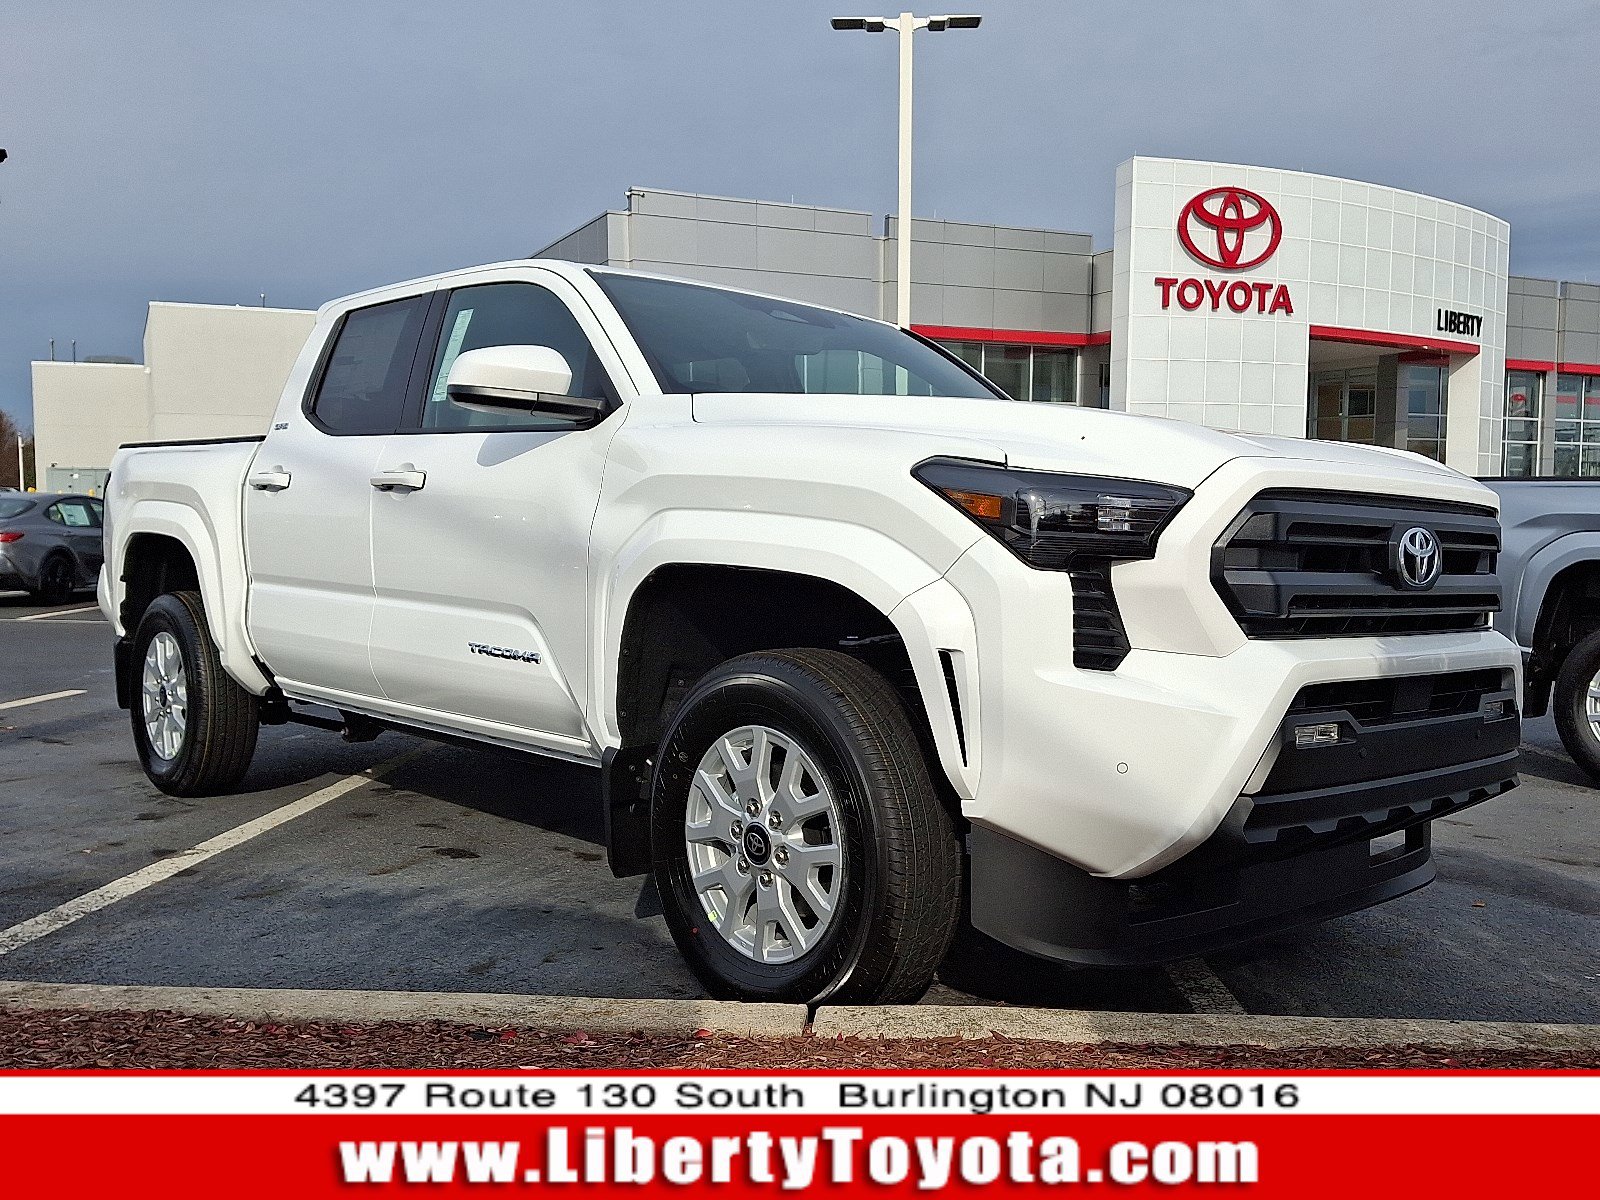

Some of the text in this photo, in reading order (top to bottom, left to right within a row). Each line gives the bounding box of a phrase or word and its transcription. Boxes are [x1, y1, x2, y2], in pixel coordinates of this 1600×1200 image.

[1155, 277, 1294, 315] TOYOTA
[1437, 308, 1483, 337] LIBERTY
[467, 641, 541, 665] TACOMA
